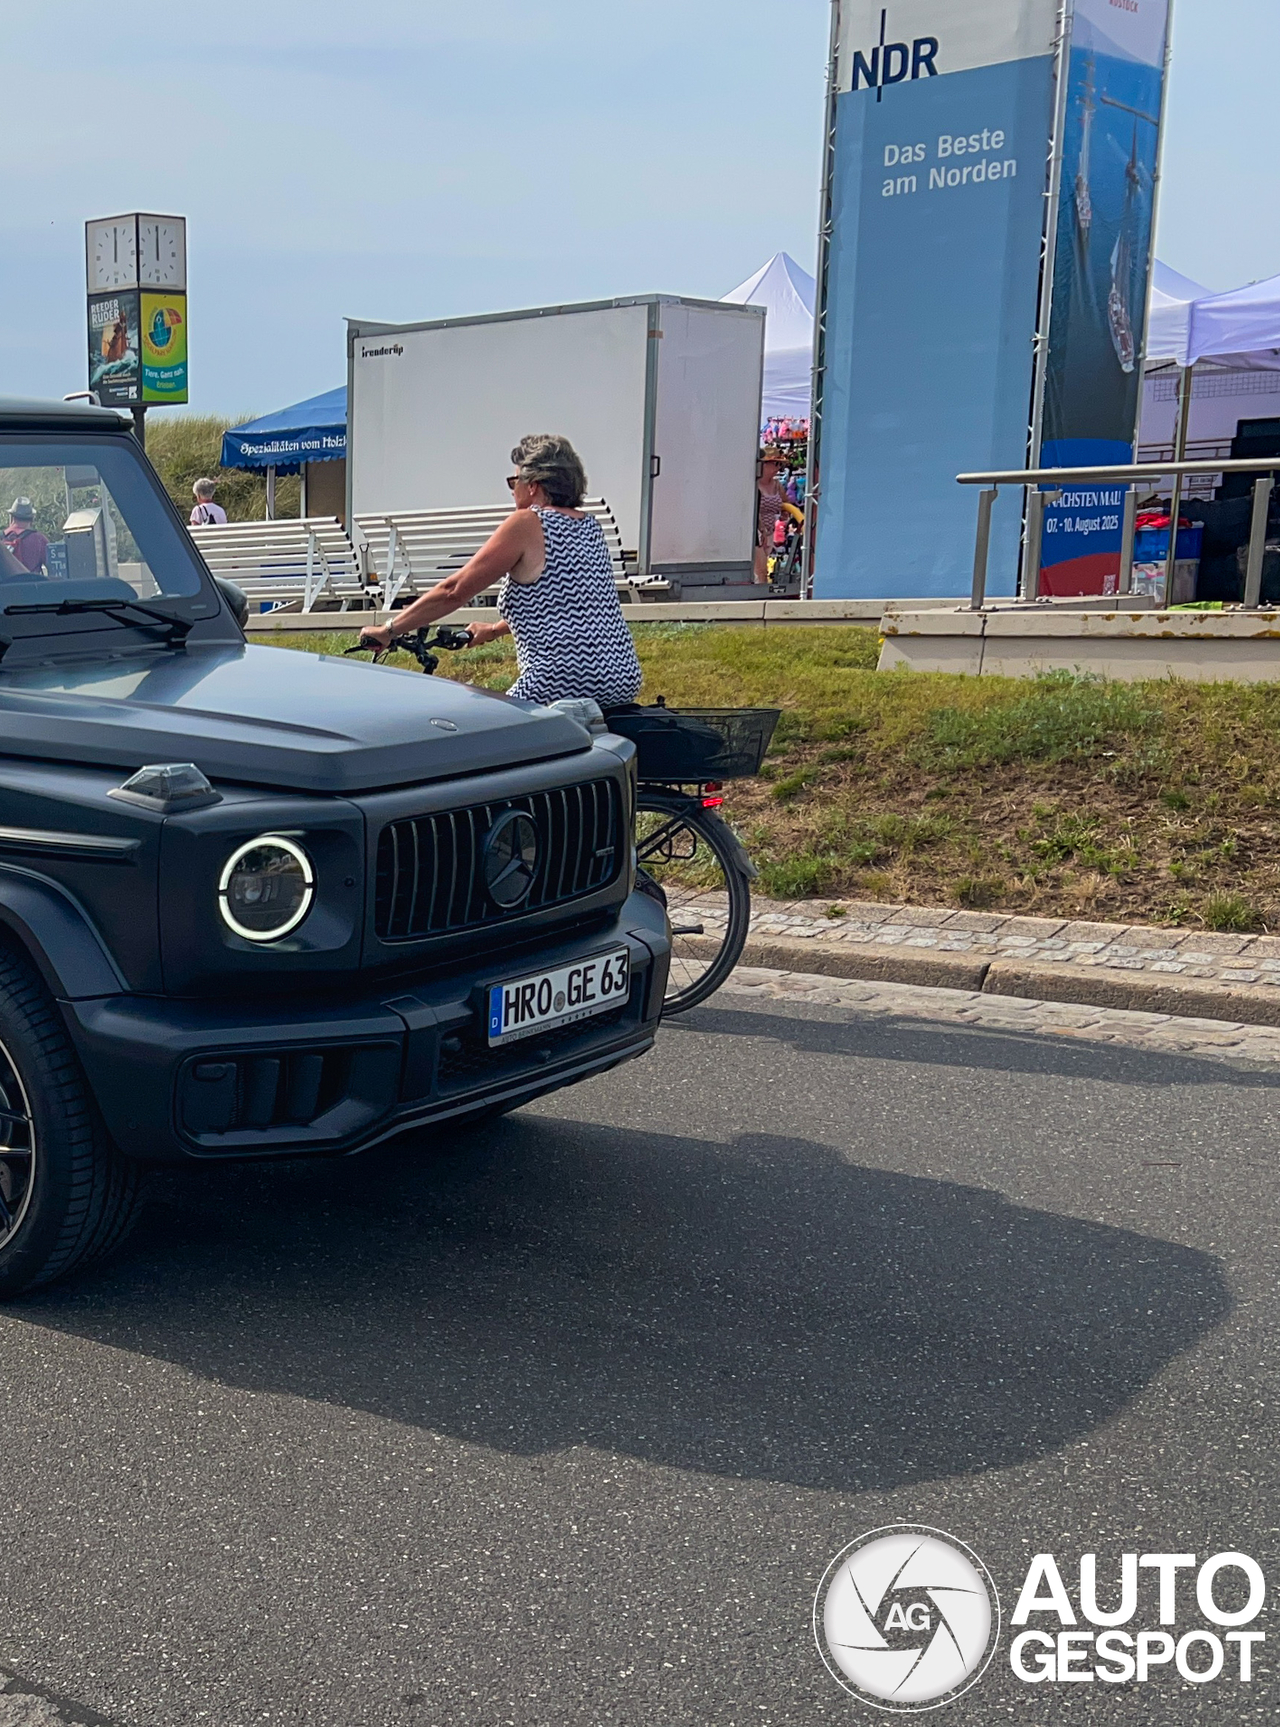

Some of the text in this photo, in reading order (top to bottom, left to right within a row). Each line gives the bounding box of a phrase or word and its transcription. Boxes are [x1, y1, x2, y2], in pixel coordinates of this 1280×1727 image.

[851, 36, 939, 91] NDR
[883, 127, 1005, 167] Das Beste
[881, 158, 1018, 197] am Norden
[91, 299, 119, 313] REEDER
[91, 309, 120, 324] RUDER
[240, 440, 300, 456] Spezialitäten
[301, 440, 321, 450] vom
[1099, 490, 1122, 506] MAL!
[1074, 516, 1100, 536] August
[1101, 515, 1119, 530] 2025
[504, 955, 627, 1027] HRO GE 63
[491, 1016, 499, 1029] D
